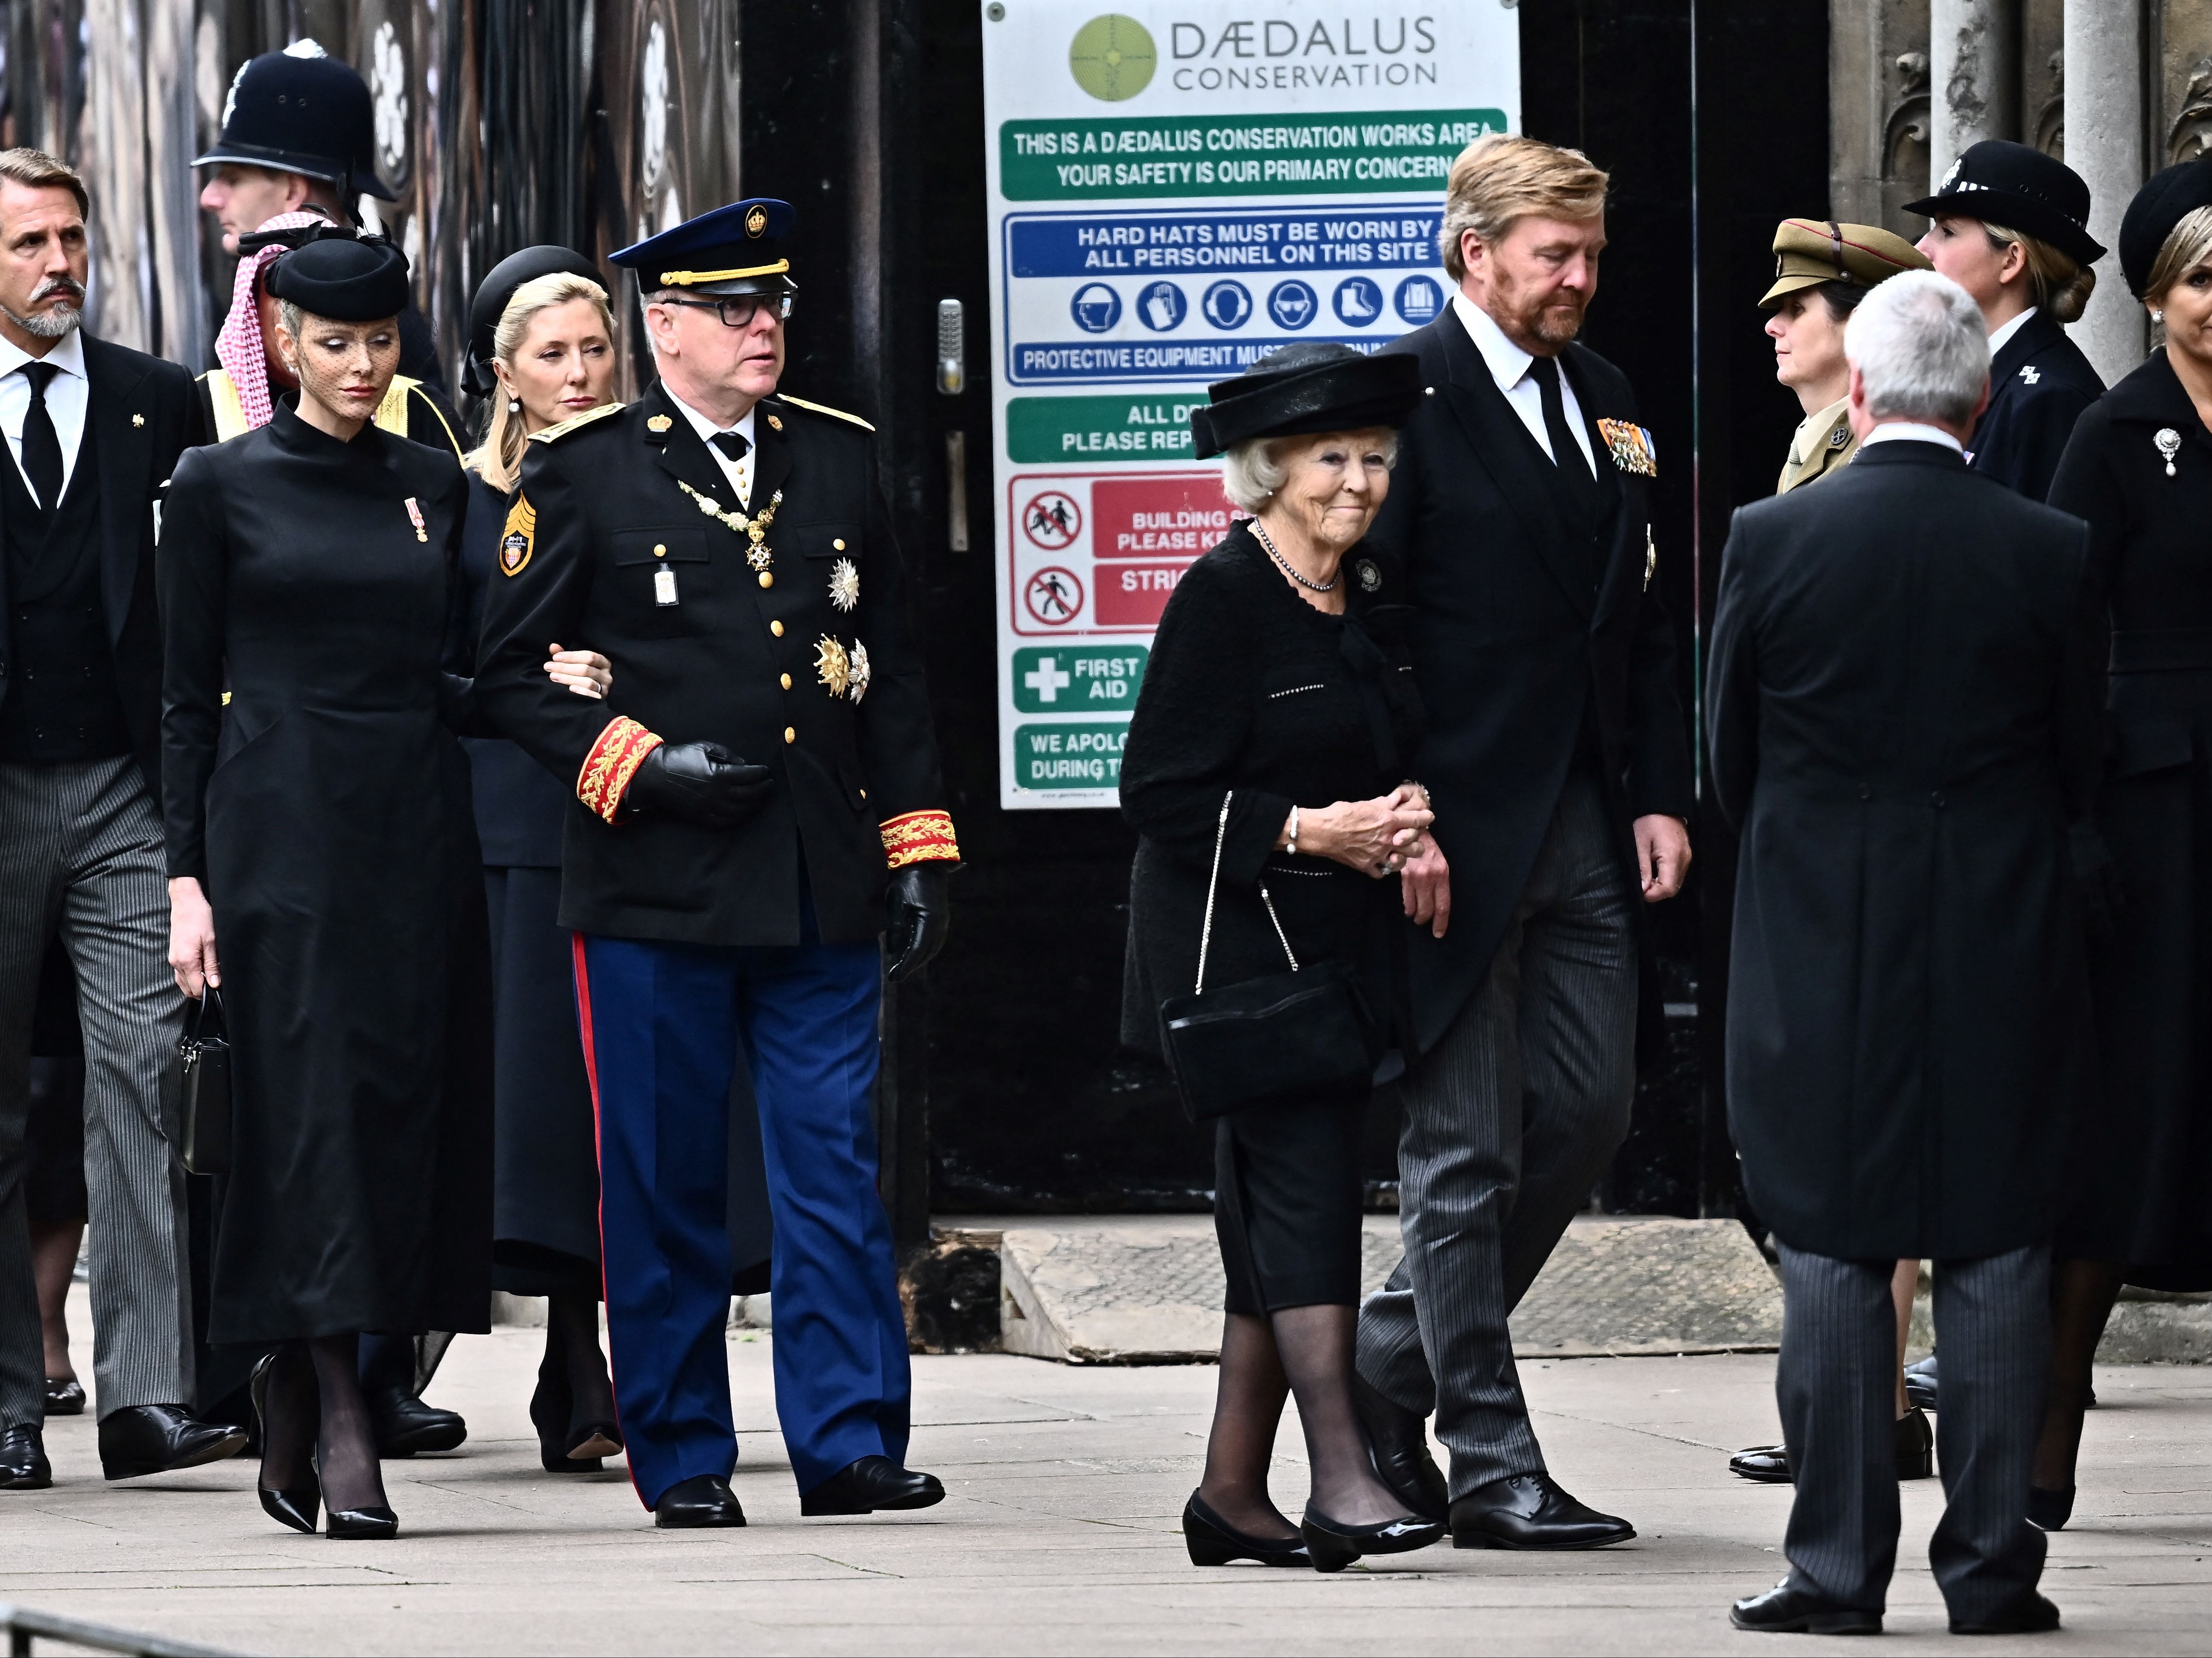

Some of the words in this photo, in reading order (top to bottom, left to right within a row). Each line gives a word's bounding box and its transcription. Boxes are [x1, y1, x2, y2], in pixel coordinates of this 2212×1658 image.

[1171, 16, 1435, 59] DÆDALUS
[1173, 62, 1436, 90] CONSERVATION
[1013, 133, 1058, 155] THIS
[1061, 132, 1080, 154] IS
[1082, 132, 1097, 154] A
[1101, 129, 1202, 153] DÆDALUS
[1206, 126, 1357, 151] CONSERVATION
[1361, 123, 1435, 147] WORKS
[1438, 121, 1491, 145] AREA
[1057, 164, 1112, 186] YOUR
[1115, 162, 1191, 185] SAFETY
[1196, 161, 1215, 184] IS
[1218, 160, 1260, 183] OUR
[1264, 158, 1351, 181] PRIMARY
[1355, 155, 1452, 179] CONCERN
[1078, 227, 1145, 246] HARD
[1150, 224, 1213, 244] HATS
[1217, 223, 1283, 243] MUST
[1288, 222, 1319, 242] BE
[1324, 221, 1398, 240] WORN
[1401, 220, 1433, 239] BY
[1085, 249, 1129, 268] ALL
[1134, 245, 1276, 267] PERSONNEL
[1280, 244, 1315, 264] ON
[1320, 243, 1373, 263] THIS
[1378, 242, 1430, 261] SITE
[1023, 348, 1132, 370] PROTECTIVE
[1134, 346, 1234, 367] EQUIPMENT
[1126, 405, 1169, 424] ALL
[1062, 431, 1147, 451] PLEASE
[1132, 511, 1226, 530] BUILDING
[1117, 532, 1197, 550] PLEASE
[1075, 658, 1140, 678] FIRST
[1088, 680, 1128, 699] AID
[1030, 734, 1062, 753] WE
[1031, 759, 1104, 780] DURING
